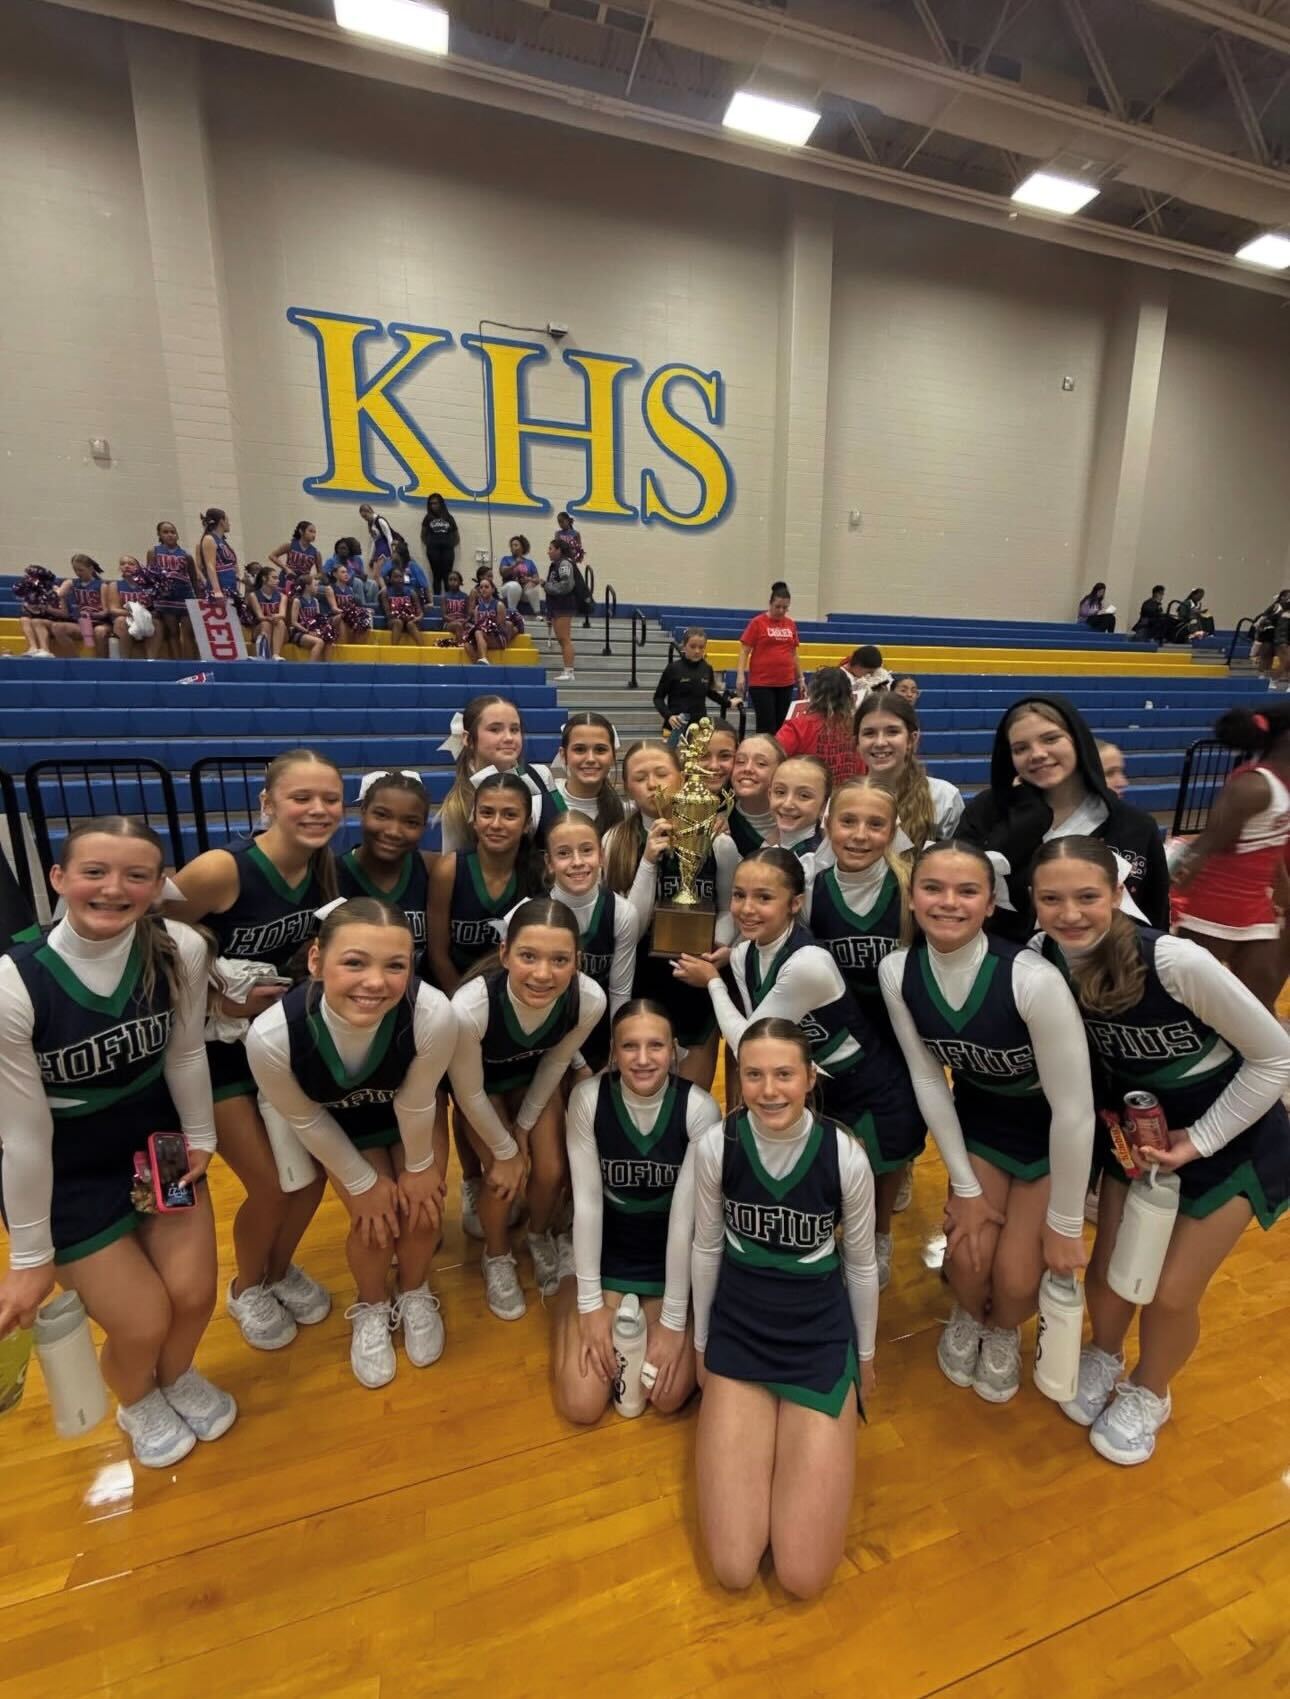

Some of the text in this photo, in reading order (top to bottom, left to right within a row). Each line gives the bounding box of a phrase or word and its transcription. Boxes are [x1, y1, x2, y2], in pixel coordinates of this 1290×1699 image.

[287, 306, 734, 530] KHS
[198, 598, 238, 661] RED
[36, 1009, 175, 1083] HOFIU
[1080, 1019, 1204, 1060] FIUS
